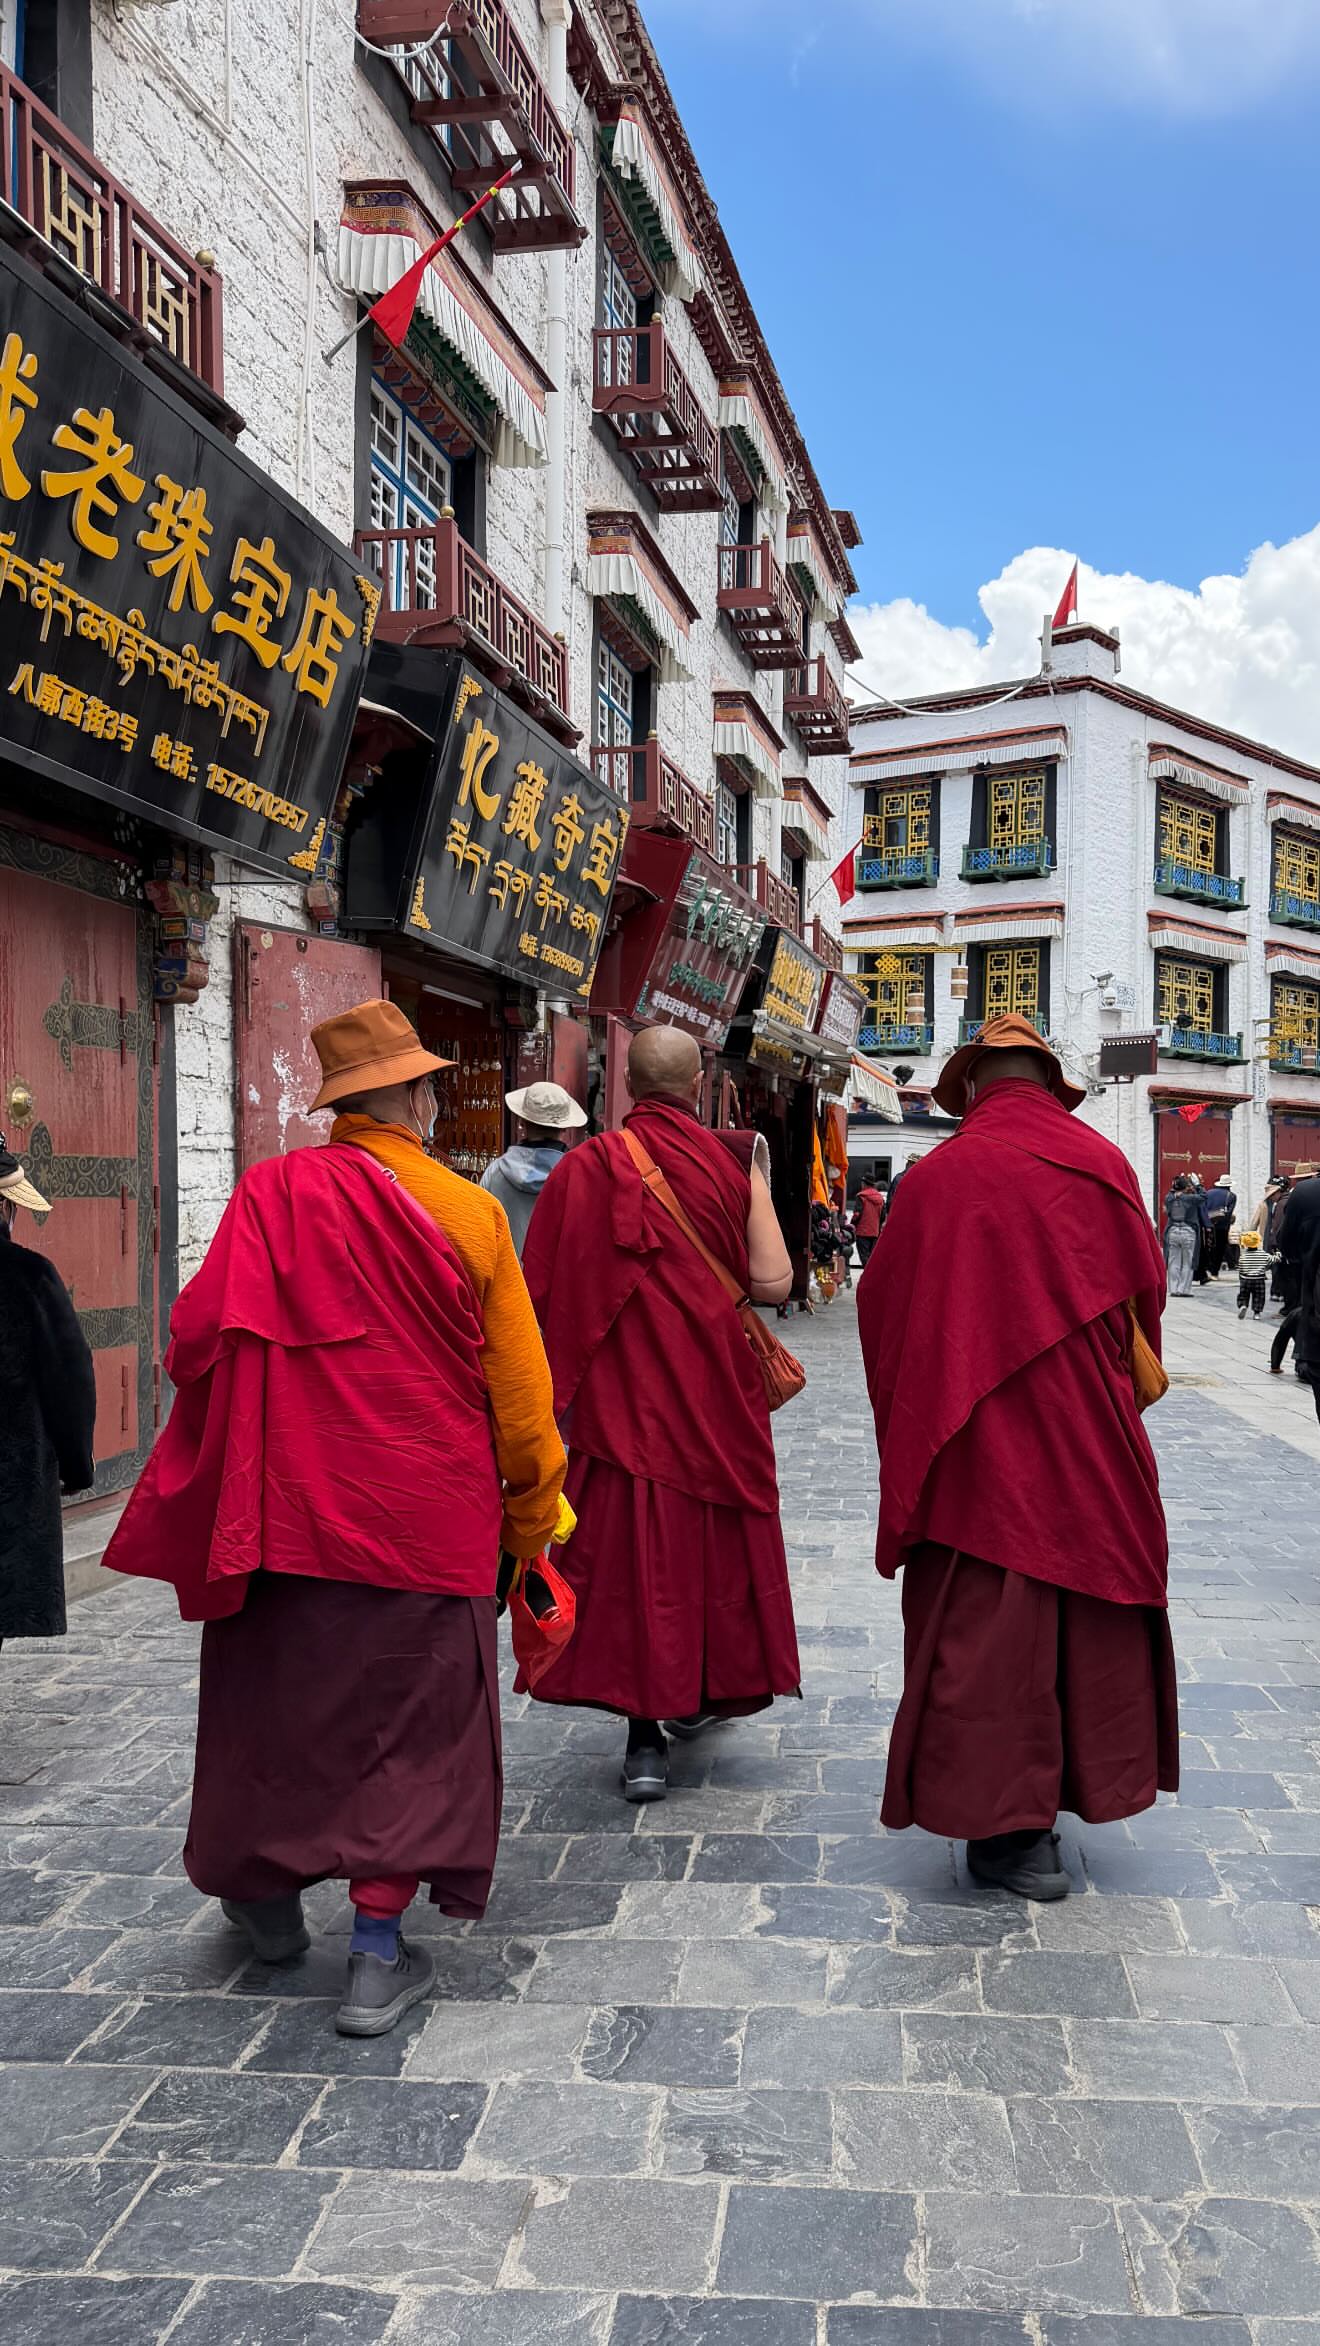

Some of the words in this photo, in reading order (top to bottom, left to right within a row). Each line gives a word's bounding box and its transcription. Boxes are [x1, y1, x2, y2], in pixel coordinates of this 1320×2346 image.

[8, 663, 139, 752] 八廓西街3号
[206, 763, 309, 833] 15726702557
[458, 717, 618, 896] 忆藏奇宝
